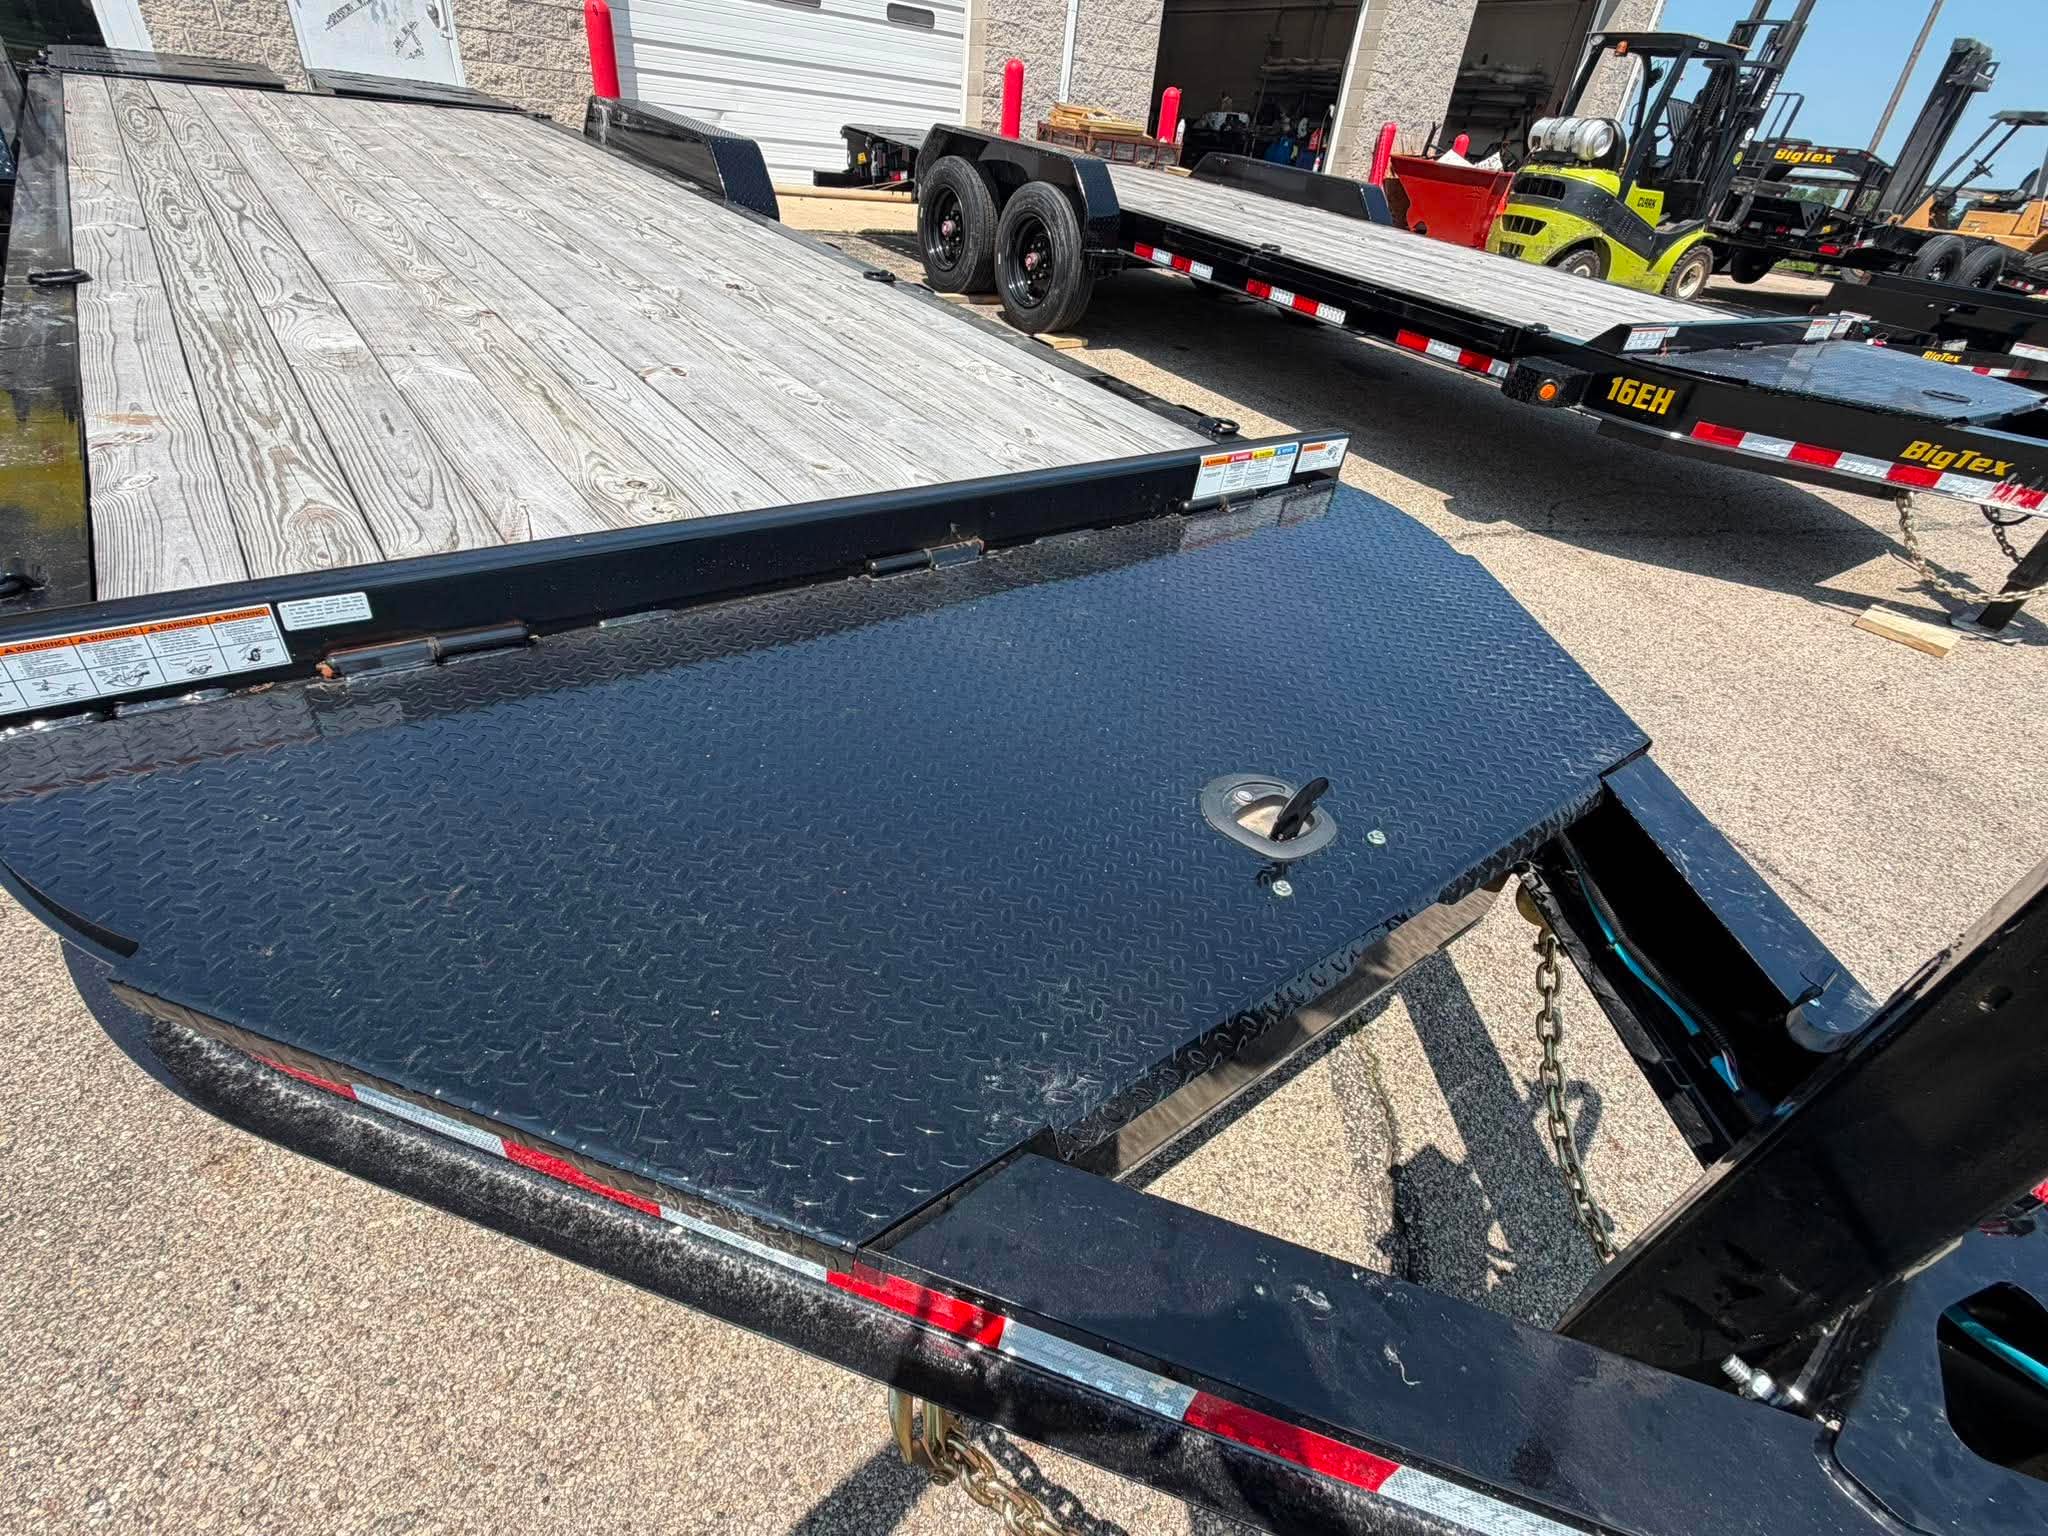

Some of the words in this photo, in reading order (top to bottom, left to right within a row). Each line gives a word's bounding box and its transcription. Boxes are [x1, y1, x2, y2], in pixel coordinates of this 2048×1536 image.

[1774, 148, 1836, 163] BigTex
[1922, 351, 1962, 363] BigTex
[1607, 376, 1676, 415] 16EH
[1900, 440, 2015, 477] BigTex
[221, 609, 266, 621] WARNING
[157, 619, 204, 631] WARNING
[87, 629, 138, 641] WARNING
[15, 641, 67, 652] WARNING
